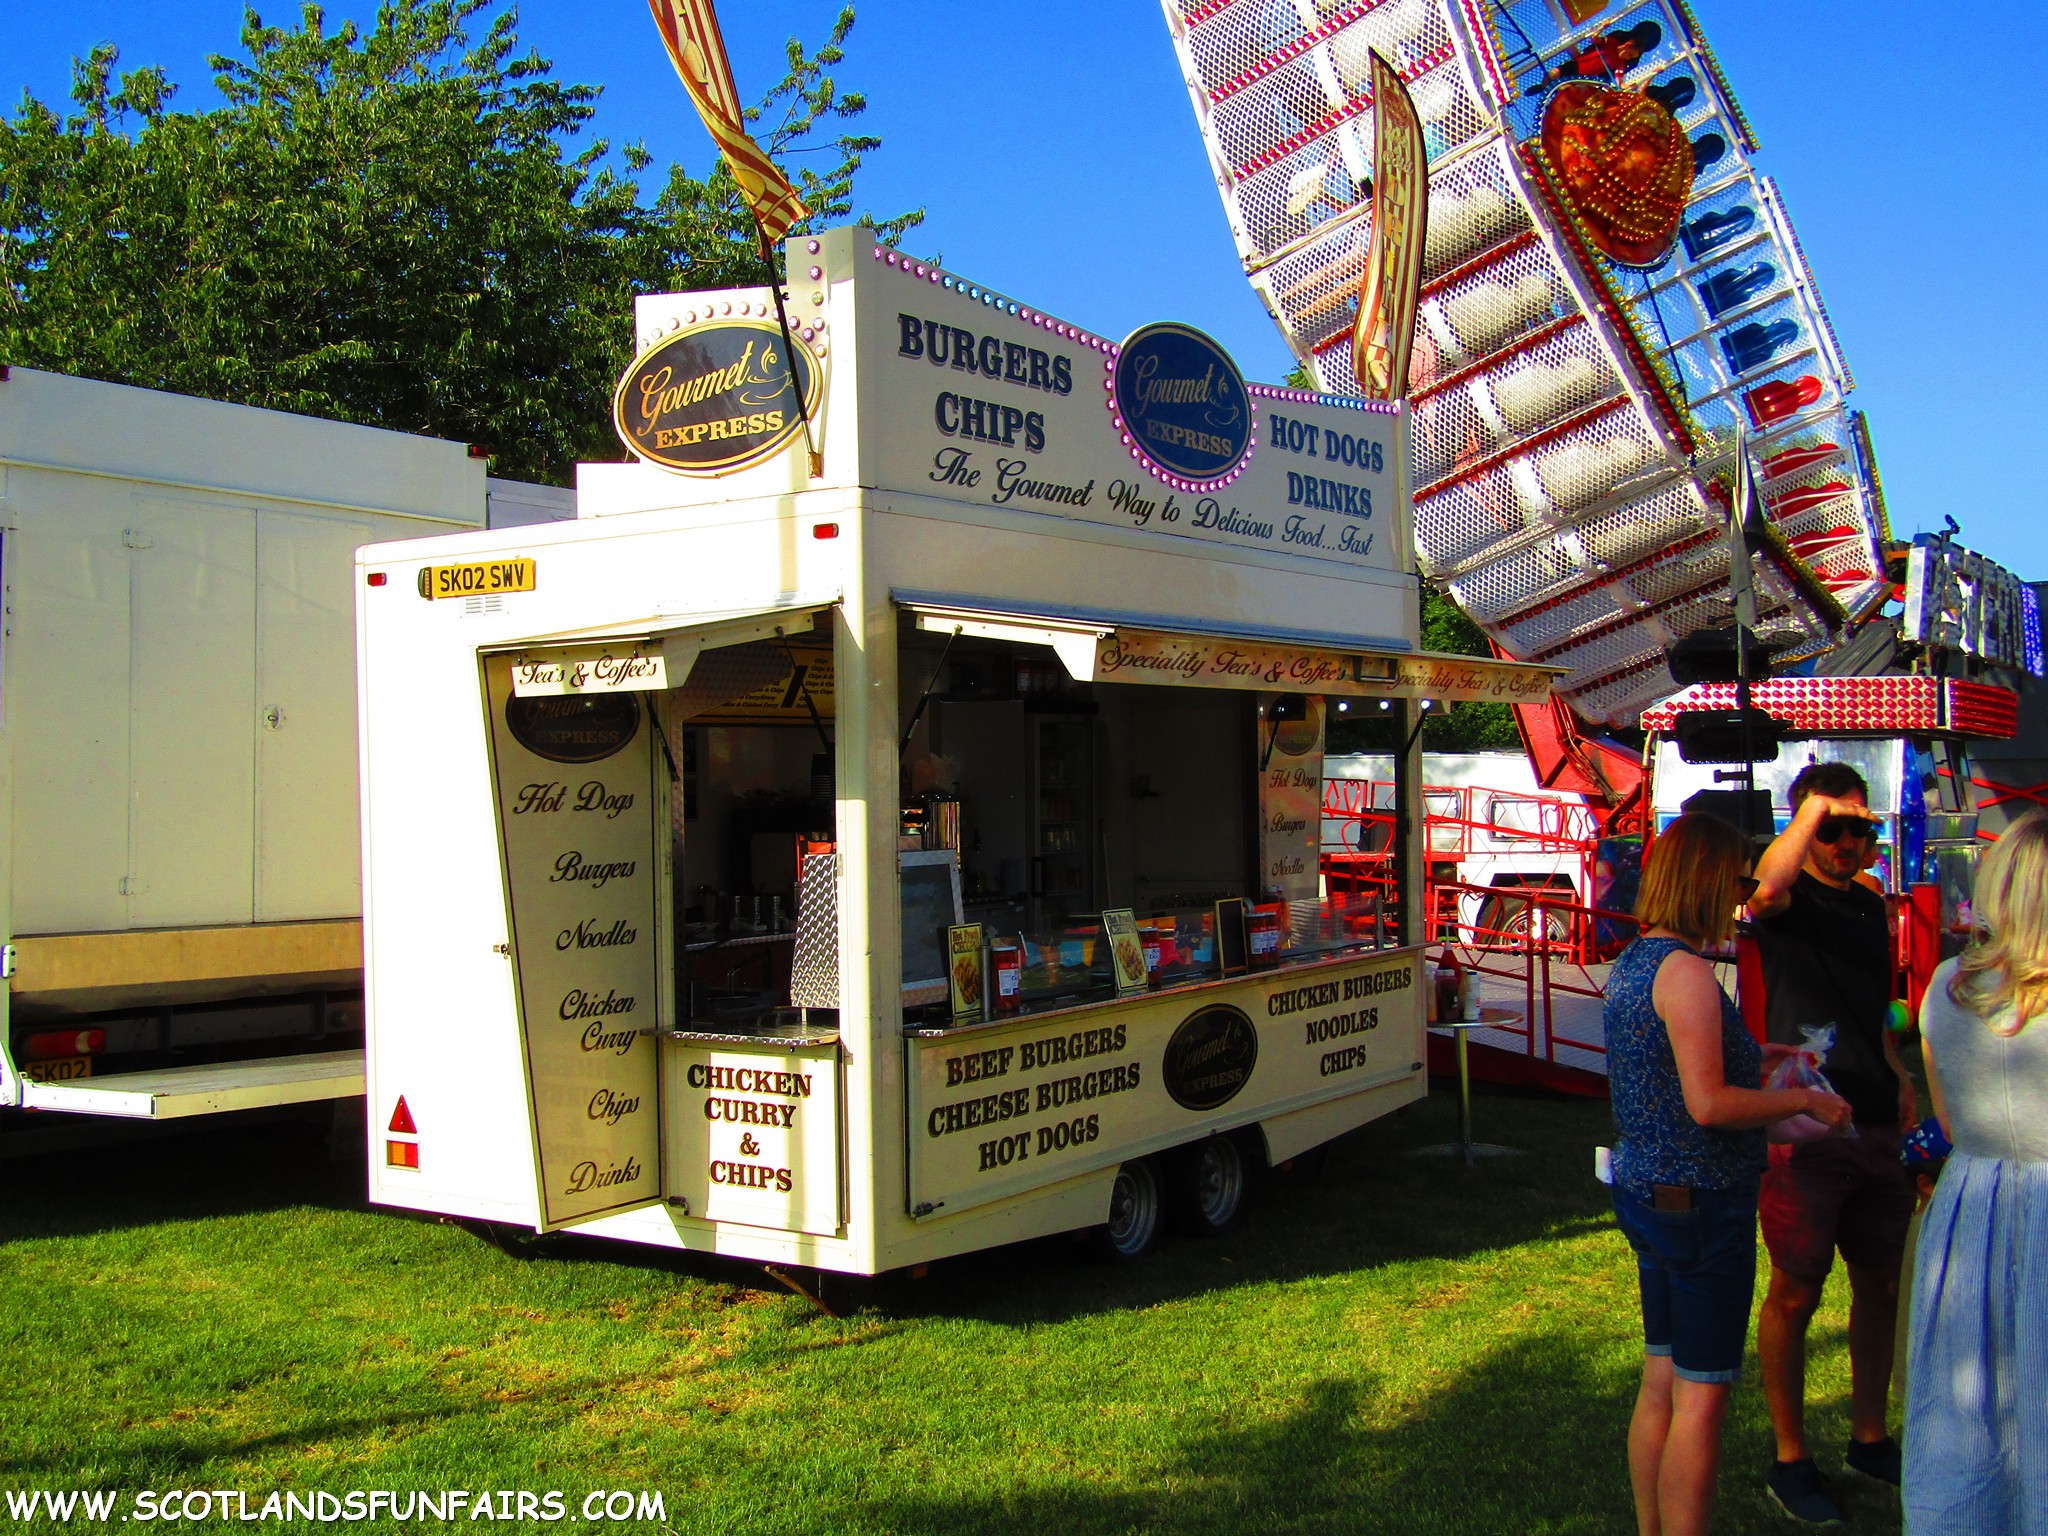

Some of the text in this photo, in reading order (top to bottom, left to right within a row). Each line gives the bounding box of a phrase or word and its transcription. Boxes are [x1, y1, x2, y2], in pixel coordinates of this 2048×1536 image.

[898, 313, 1073, 396] BURGERS
[636, 340, 754, 437] Gourmet
[1132, 354, 1214, 418] Gourmet
[655, 410, 783, 450] EXPRESS
[935, 391, 1046, 453] CHIPS
[1146, 418, 1232, 458] EXPRESS
[1269, 414, 1385, 473] HOT DOGS
[929, 447, 981, 488] The
[992, 457, 1095, 507] Gourmet
[1108, 479, 1156, 525] Way
[1161, 495, 1181, 523] to
[1192, 498, 1274, 541] Delicious
[1286, 471, 1374, 521] DRINKS
[439, 563, 525, 592] SK02 SWV
[519, 655, 657, 688] Tea's & Coffee's
[1100, 641, 1347, 685] Speciality Tea's & Coffee's
[1460, 669, 1492, 691] Tea's
[1494, 676, 1506, 695] &
[1508, 674, 1549, 696] Coffee's
[534, 730, 620, 744] EXPRESS
[1269, 767, 1318, 792] Hot Dogs
[513, 780, 634, 818] Hot Dogs
[1270, 812, 1306, 836] Burgers
[550, 850, 636, 888] Burgers
[1271, 856, 1305, 876] Noodles
[556, 918, 637, 951] Noodles
[559, 988, 637, 1021] Chicken
[1267, 966, 1412, 1017] CHICKEN BURGERS
[581, 1021, 638, 1056] Curry
[1306, 1008, 1379, 1045] NOODLES
[945, 1024, 1127, 1088] BEEF BURGERS
[1173, 1020, 1232, 1086] Gourmet
[1320, 1045, 1367, 1077] CHIPS
[687, 1063, 813, 1099] CHICKEN
[1183, 1066, 1243, 1095] EXPRESS
[587, 1089, 640, 1126] Chips
[704, 1097, 797, 1129] CURRY
[927, 1062, 1141, 1138] CHEESE BURGERS
[740, 1132, 761, 1157] &
[979, 1115, 1100, 1172] HOT DOGS
[565, 1156, 641, 1196] Drinks
[709, 1160, 793, 1194] CHIPS
